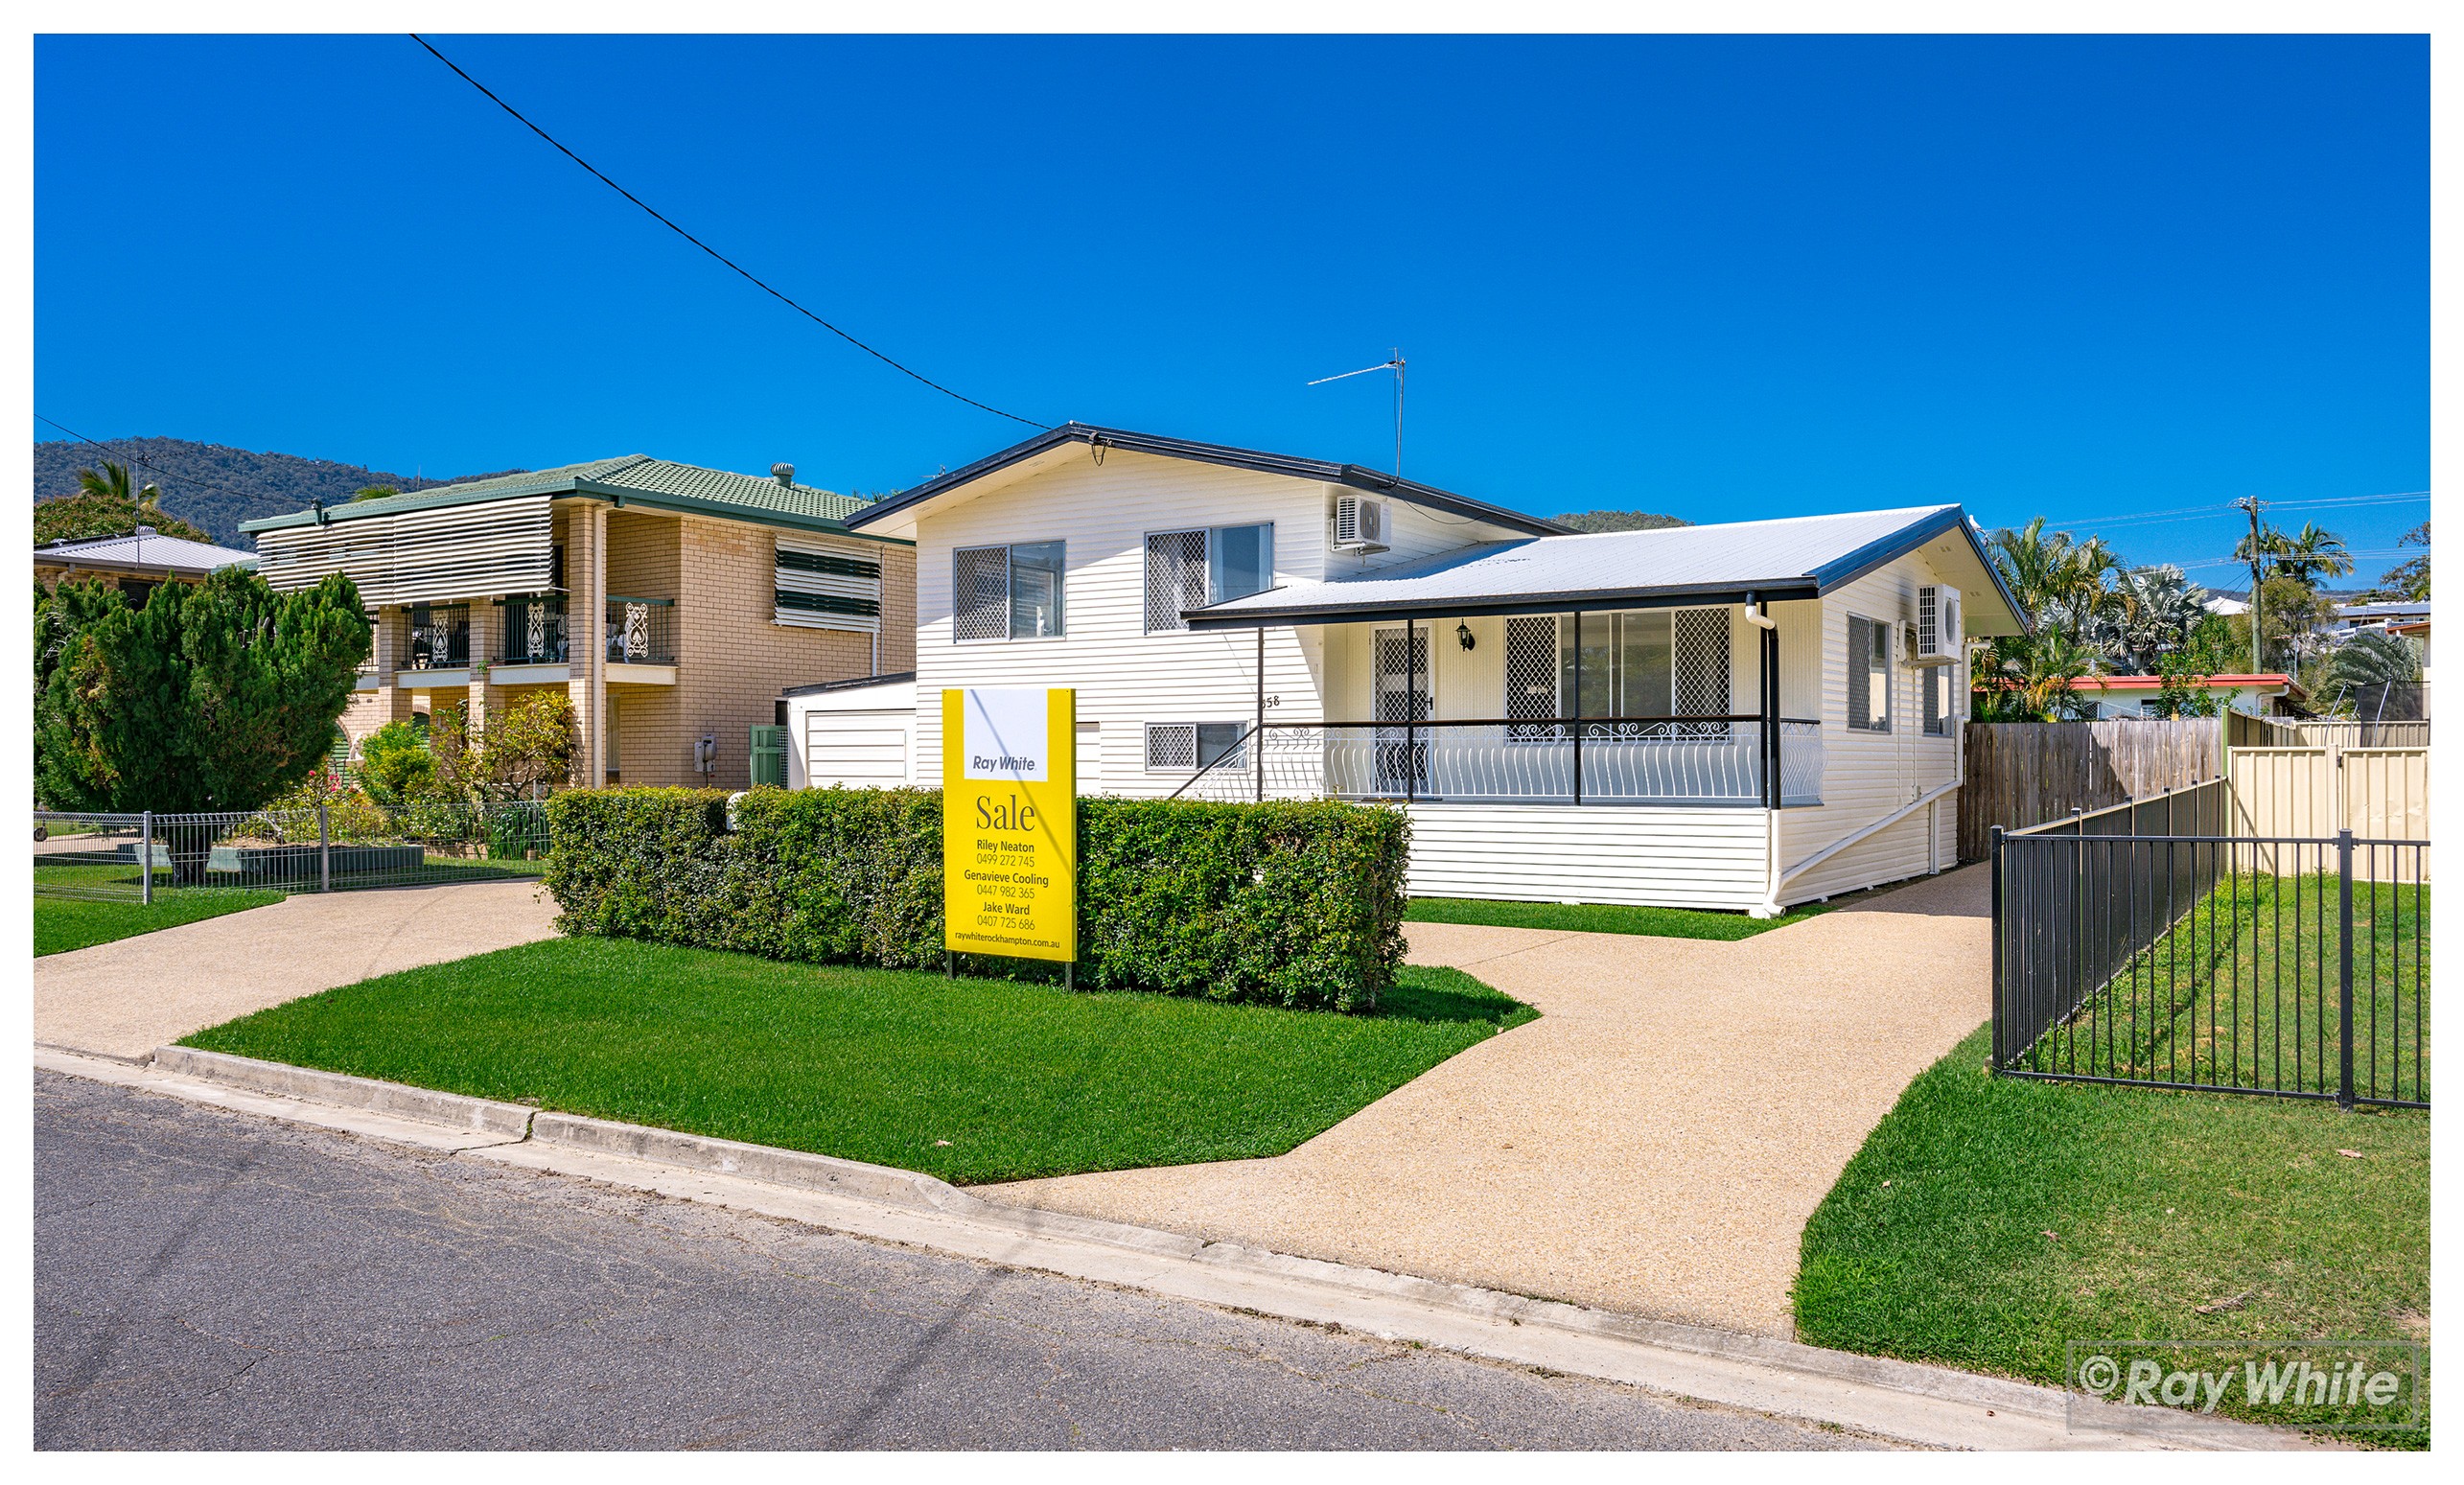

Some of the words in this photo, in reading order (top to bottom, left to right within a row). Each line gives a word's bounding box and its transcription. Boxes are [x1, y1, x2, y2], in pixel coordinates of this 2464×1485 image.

[973, 755, 997, 773] Ray
[1000, 756, 1035, 771] White
[976, 794, 1035, 832] Sale
[977, 839, 998, 853] Riley
[1000, 841, 1034, 852] Neaton
[976, 853, 998, 865] 0499
[1000, 855, 1016, 867] 272
[1018, 856, 1035, 868] 745
[964, 869, 1011, 883] Genavieve
[1012, 872, 1049, 889] Cooling
[976, 884, 998, 896] 0447
[1000, 886, 1016, 898] 982
[1018, 887, 1035, 899] 365
[983, 901, 1003, 913] Jake
[1005, 903, 1030, 916] Ward
[977, 915, 998, 927] 0407
[1000, 917, 1016, 929] 725
[1018, 918, 1035, 931] 686
[954, 932, 1060, 949] raywhiterockhampton.com.au
